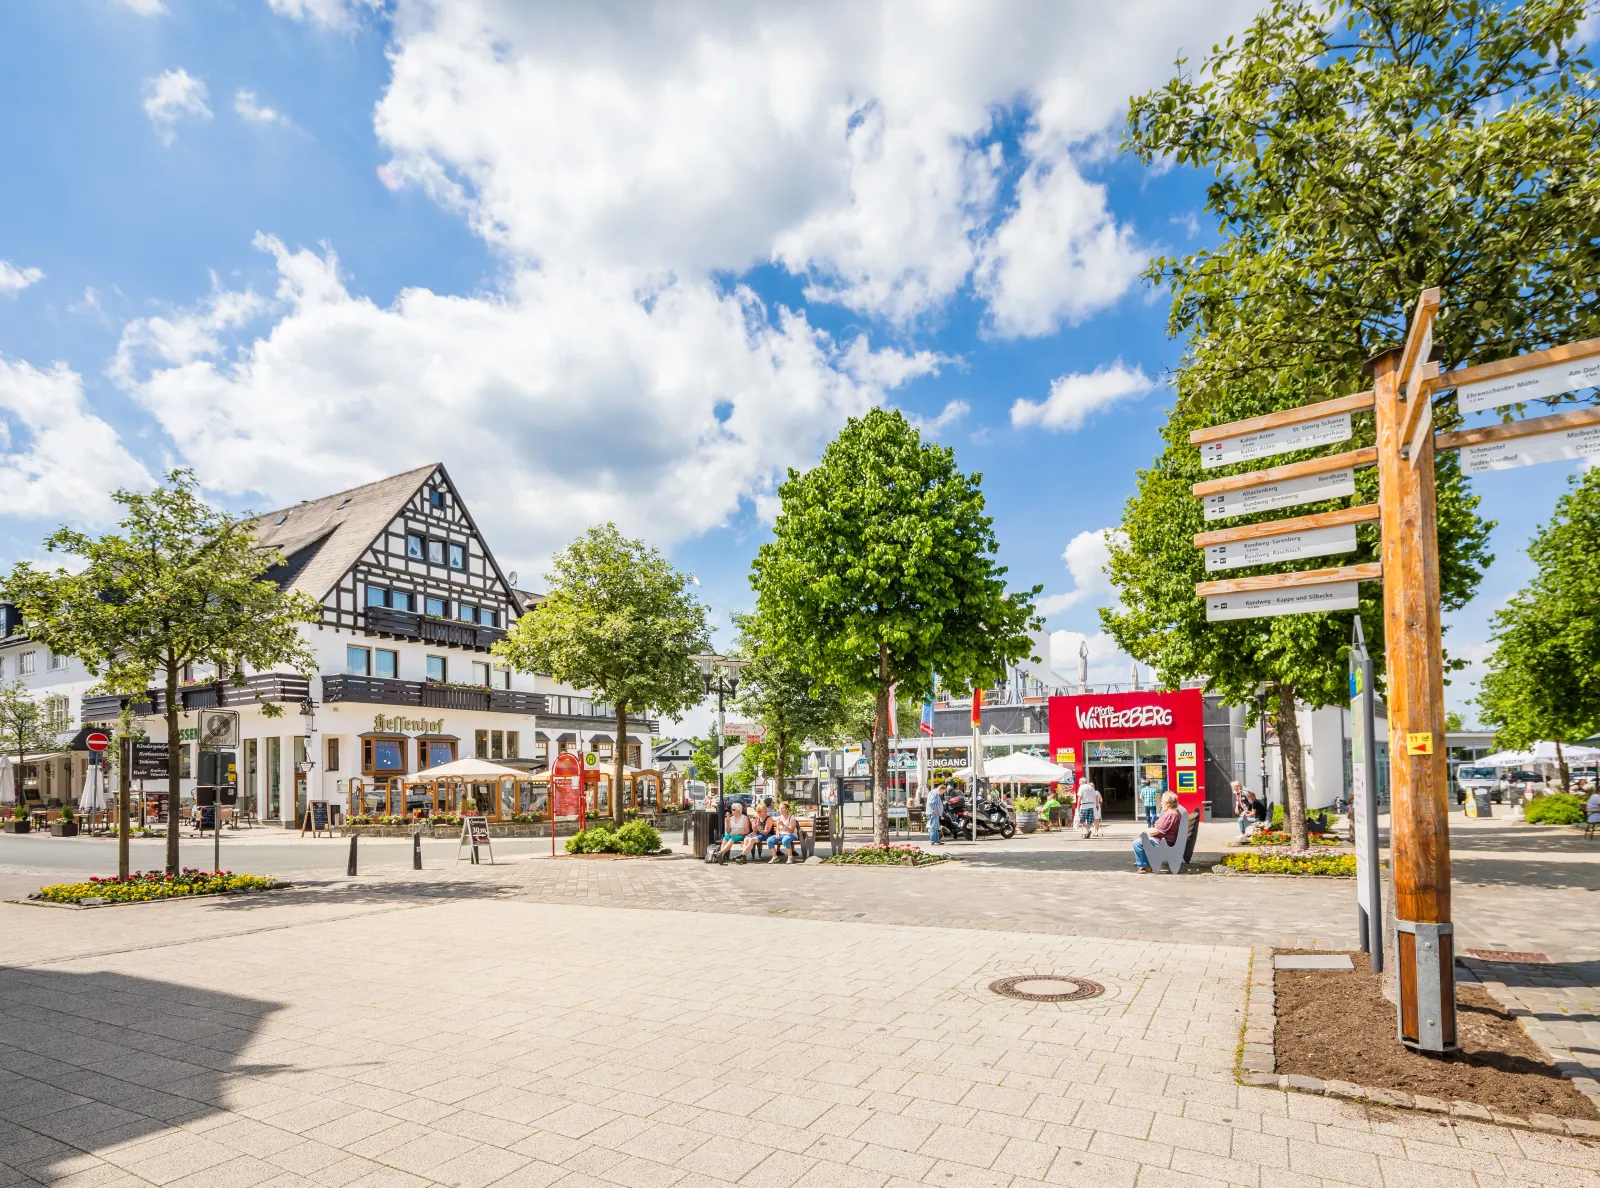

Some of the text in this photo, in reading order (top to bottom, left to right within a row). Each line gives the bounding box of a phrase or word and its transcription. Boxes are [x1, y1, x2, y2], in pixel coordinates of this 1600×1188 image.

[1466, 379, 1539, 399] Ehrenscheider Mühle
[1321, 418, 1345, 426] Schanze
[1312, 430, 1346, 439] Bürgerhaus
[1470, 444, 1505, 454] Schmantel
[1470, 454, 1518, 466] Judenfriedhof
[1318, 472, 1348, 482] Nordhang
[1243, 486, 1278, 496] Altastenberg
[1094, 706, 1114, 717] Pforte
[374, 713, 444, 734] Hessenhof
